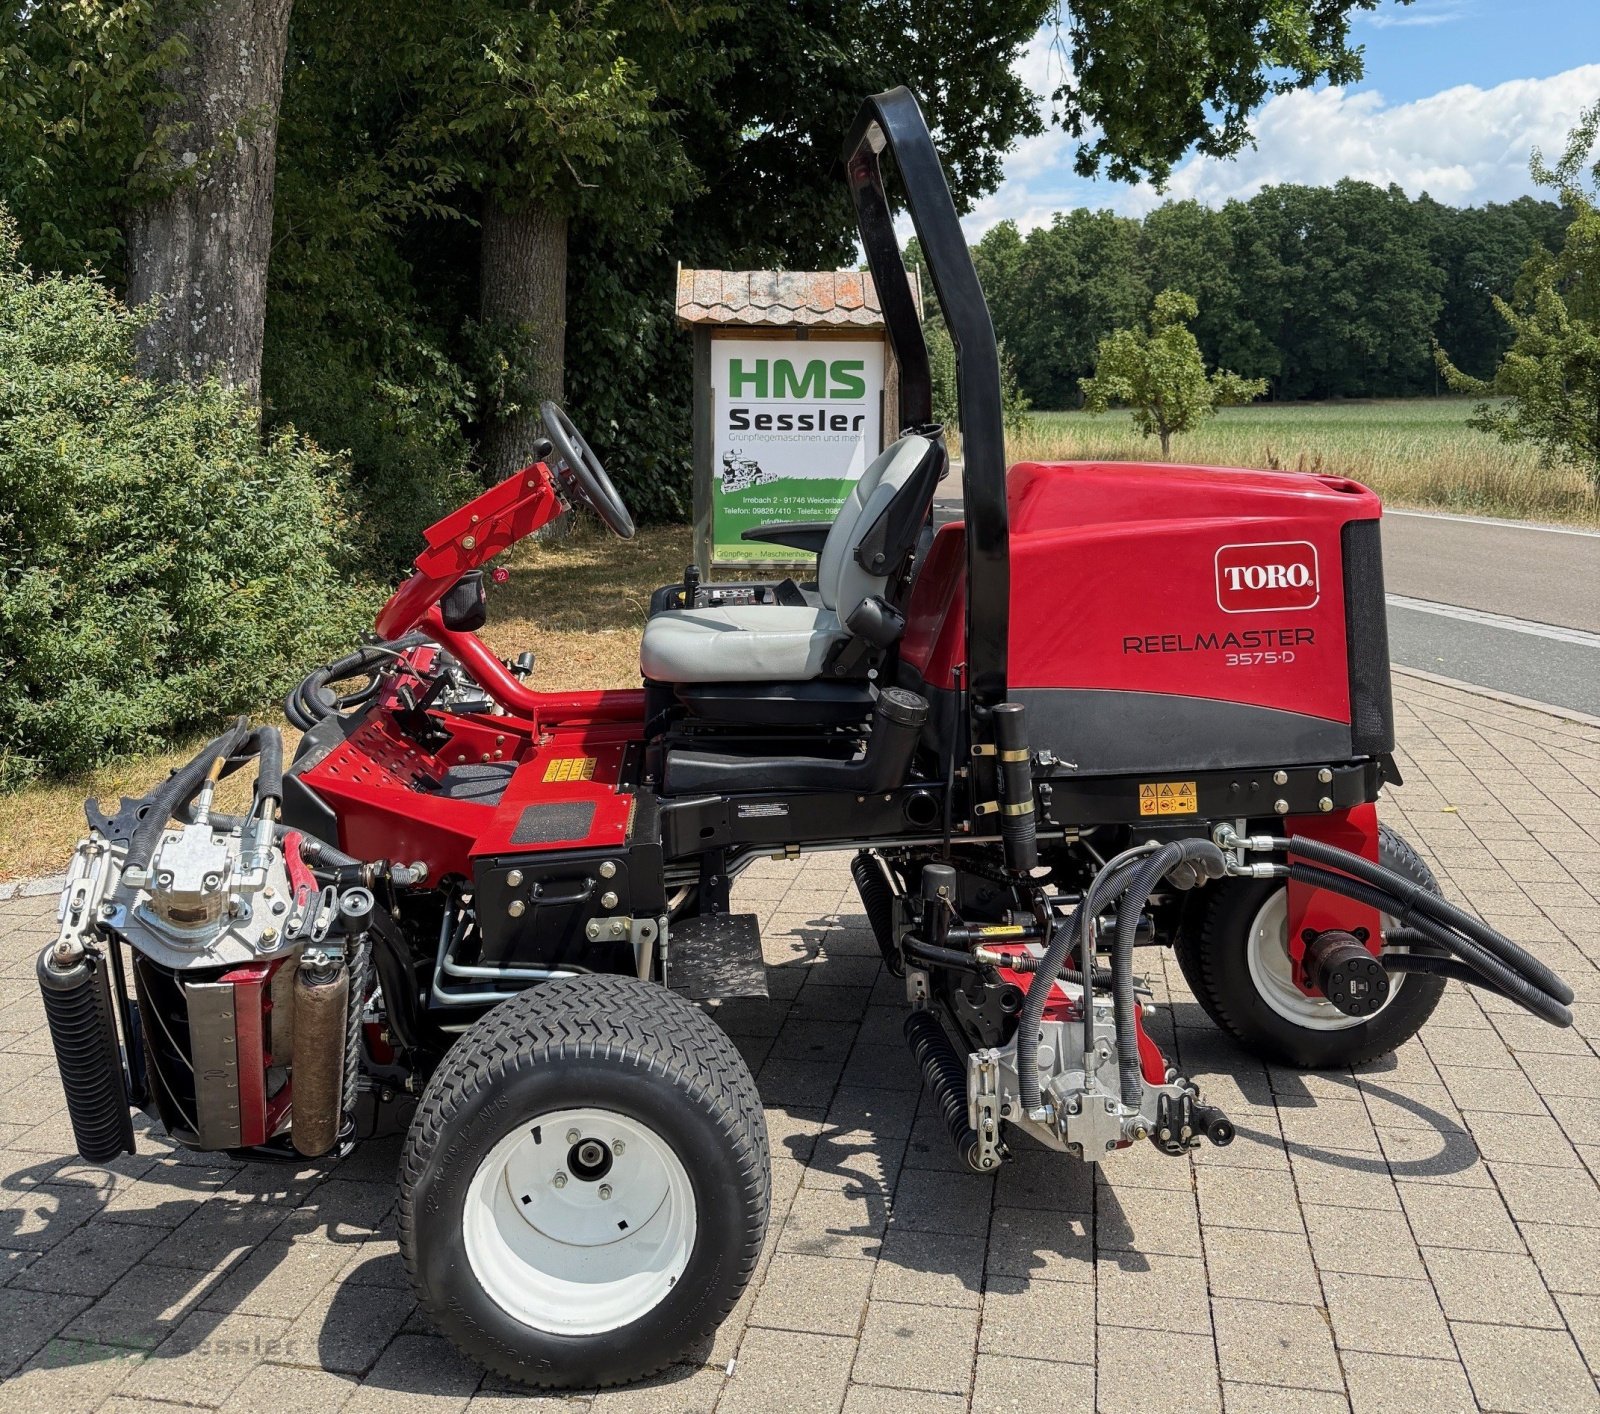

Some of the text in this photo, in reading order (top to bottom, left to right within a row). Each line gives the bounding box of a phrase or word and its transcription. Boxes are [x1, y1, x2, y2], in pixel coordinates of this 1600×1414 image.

[729, 358, 866, 399] HMS
[729, 408, 865, 432] Sessler
[728, 432, 821, 443] Grünpflegemaschinen
[823, 434, 839, 442] und
[773, 496, 778, 504] 2
[783, 496, 806, 504] 91746
[723, 507, 751, 515] Telefon:
[752, 507, 792, 515] 09826/410
[797, 507, 824, 515] Telefax:
[716, 550, 753, 559] Grünpflege
[1123, 628, 1316, 655] REELMASTER
